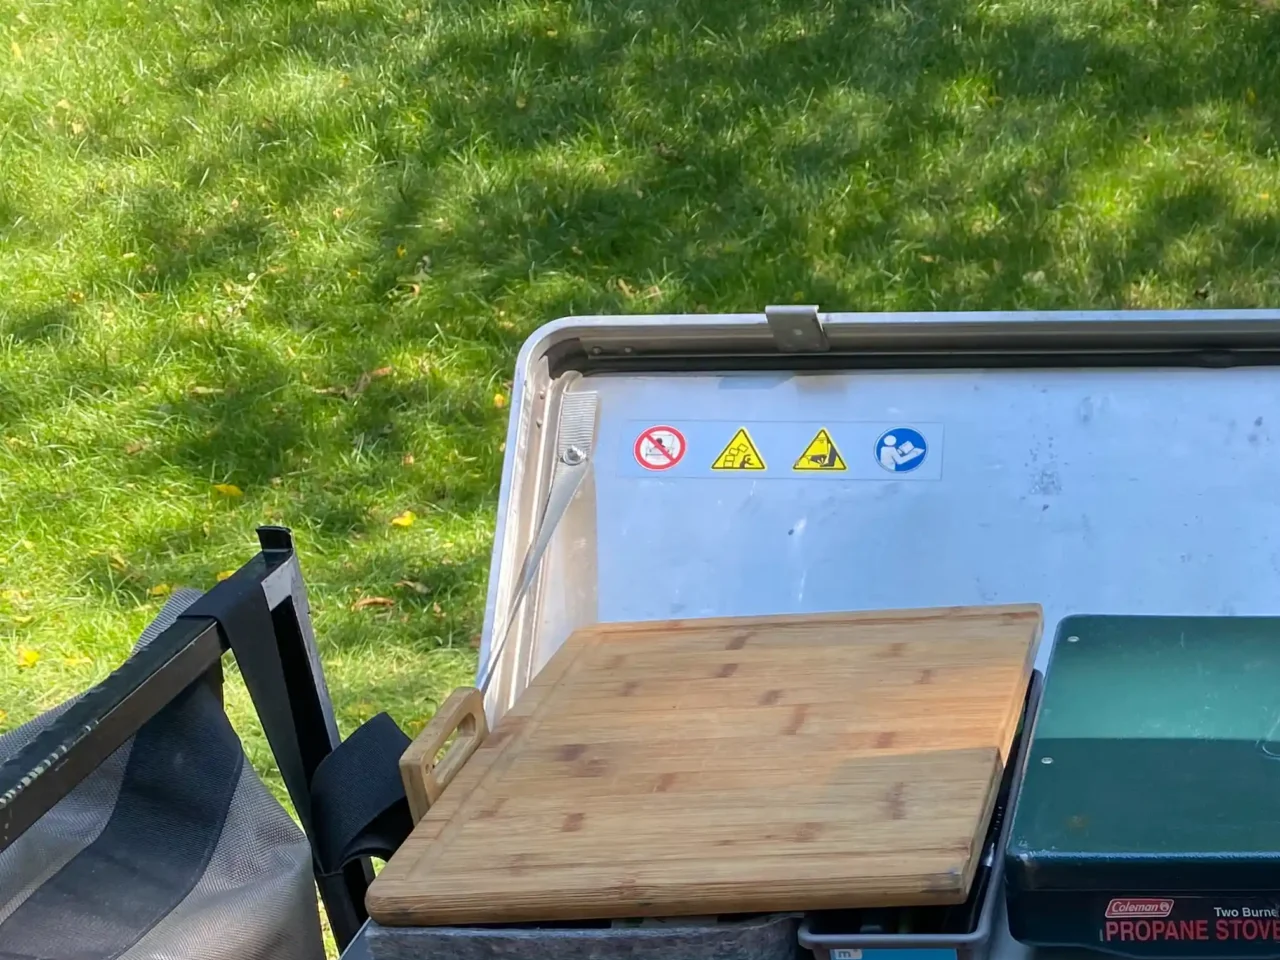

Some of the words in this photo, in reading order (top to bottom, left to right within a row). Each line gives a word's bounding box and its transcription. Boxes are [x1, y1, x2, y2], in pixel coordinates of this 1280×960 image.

[1111, 901, 1159, 913] Coleman
[1213, 906, 1240, 917] Two
[1241, 906, 1279, 918] Burne
[1105, 920, 1209, 942] PROPANE
